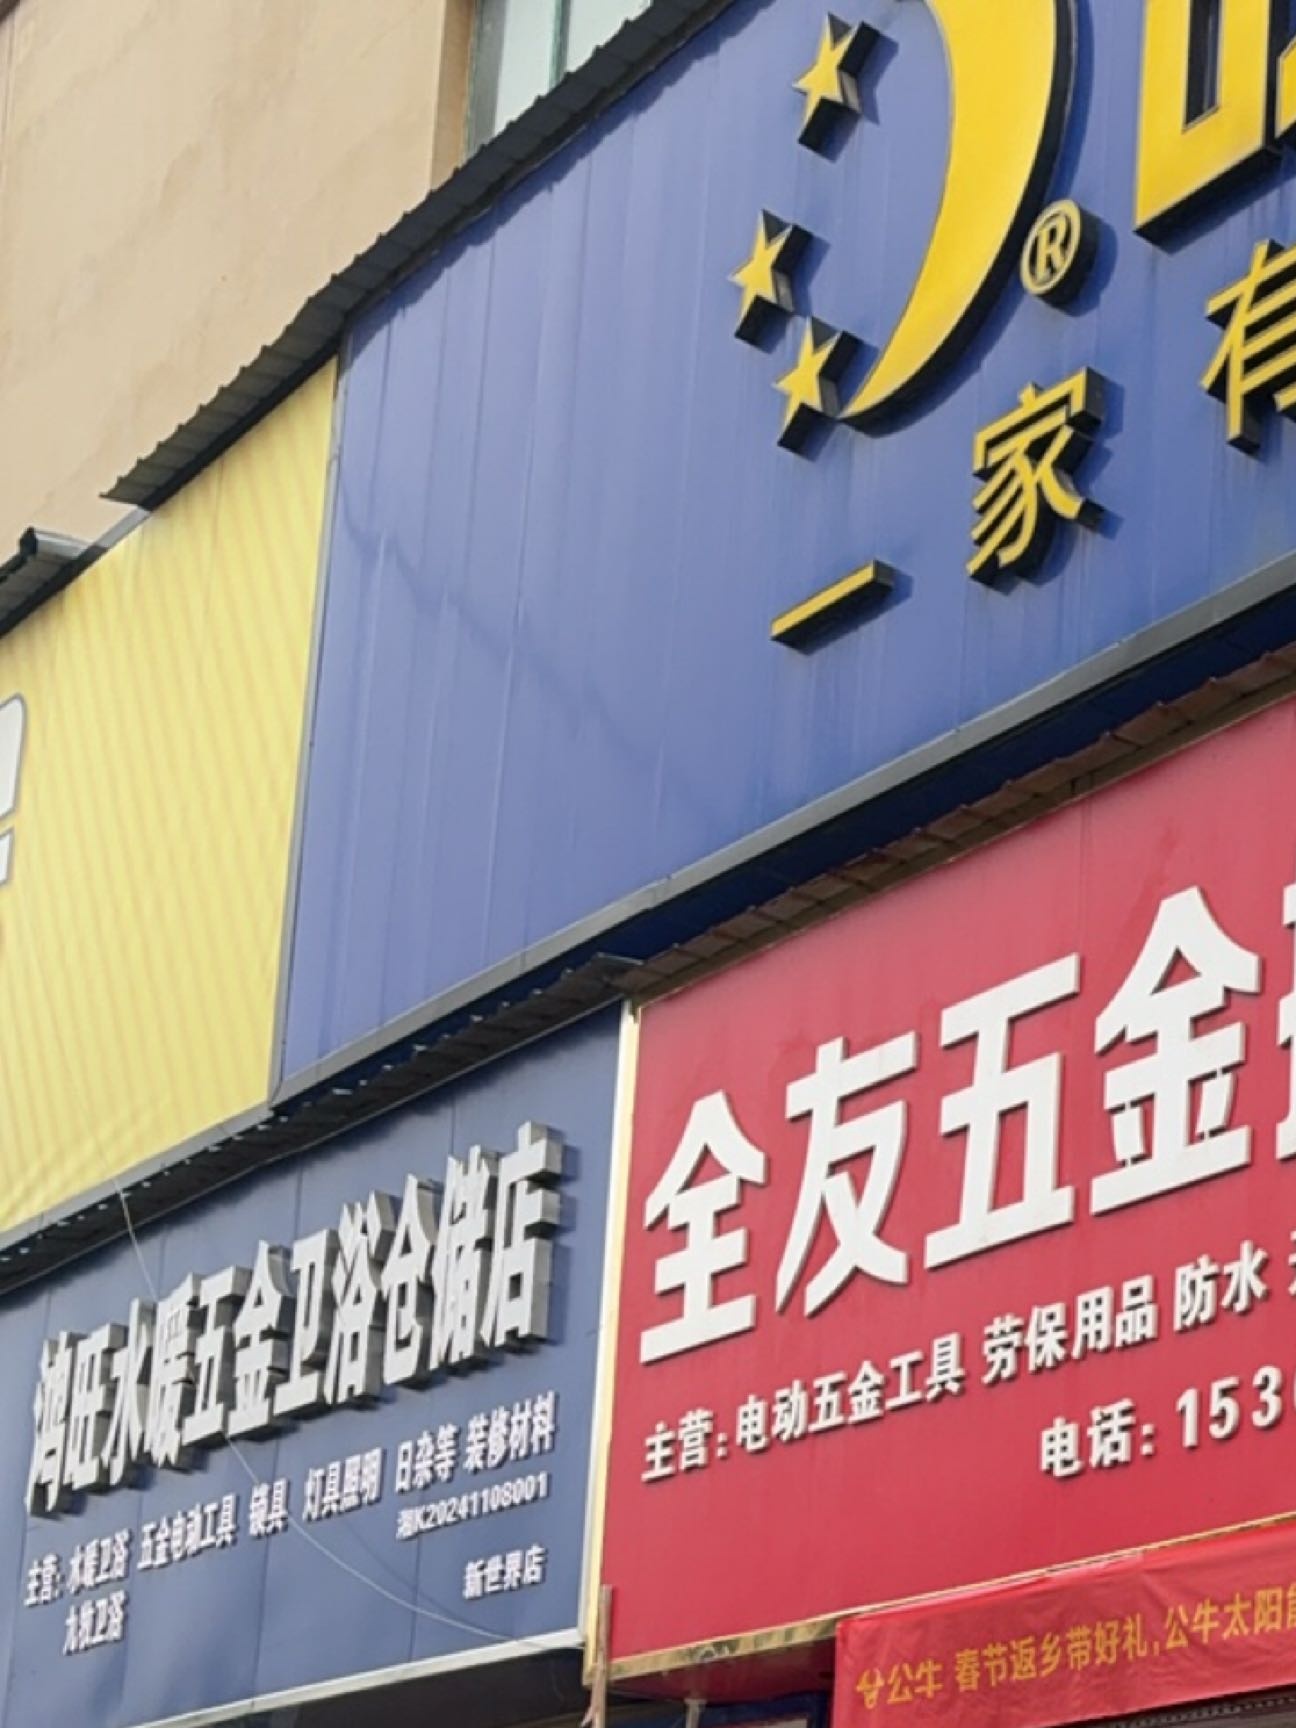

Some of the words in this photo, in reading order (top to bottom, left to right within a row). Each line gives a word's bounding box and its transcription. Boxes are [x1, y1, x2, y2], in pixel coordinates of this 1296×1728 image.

[981, 1274, 1157, 1385] 劳保用品
[1174, 1240, 1269, 1329] 防水
[887, 1661, 943, 1704] 公牛
